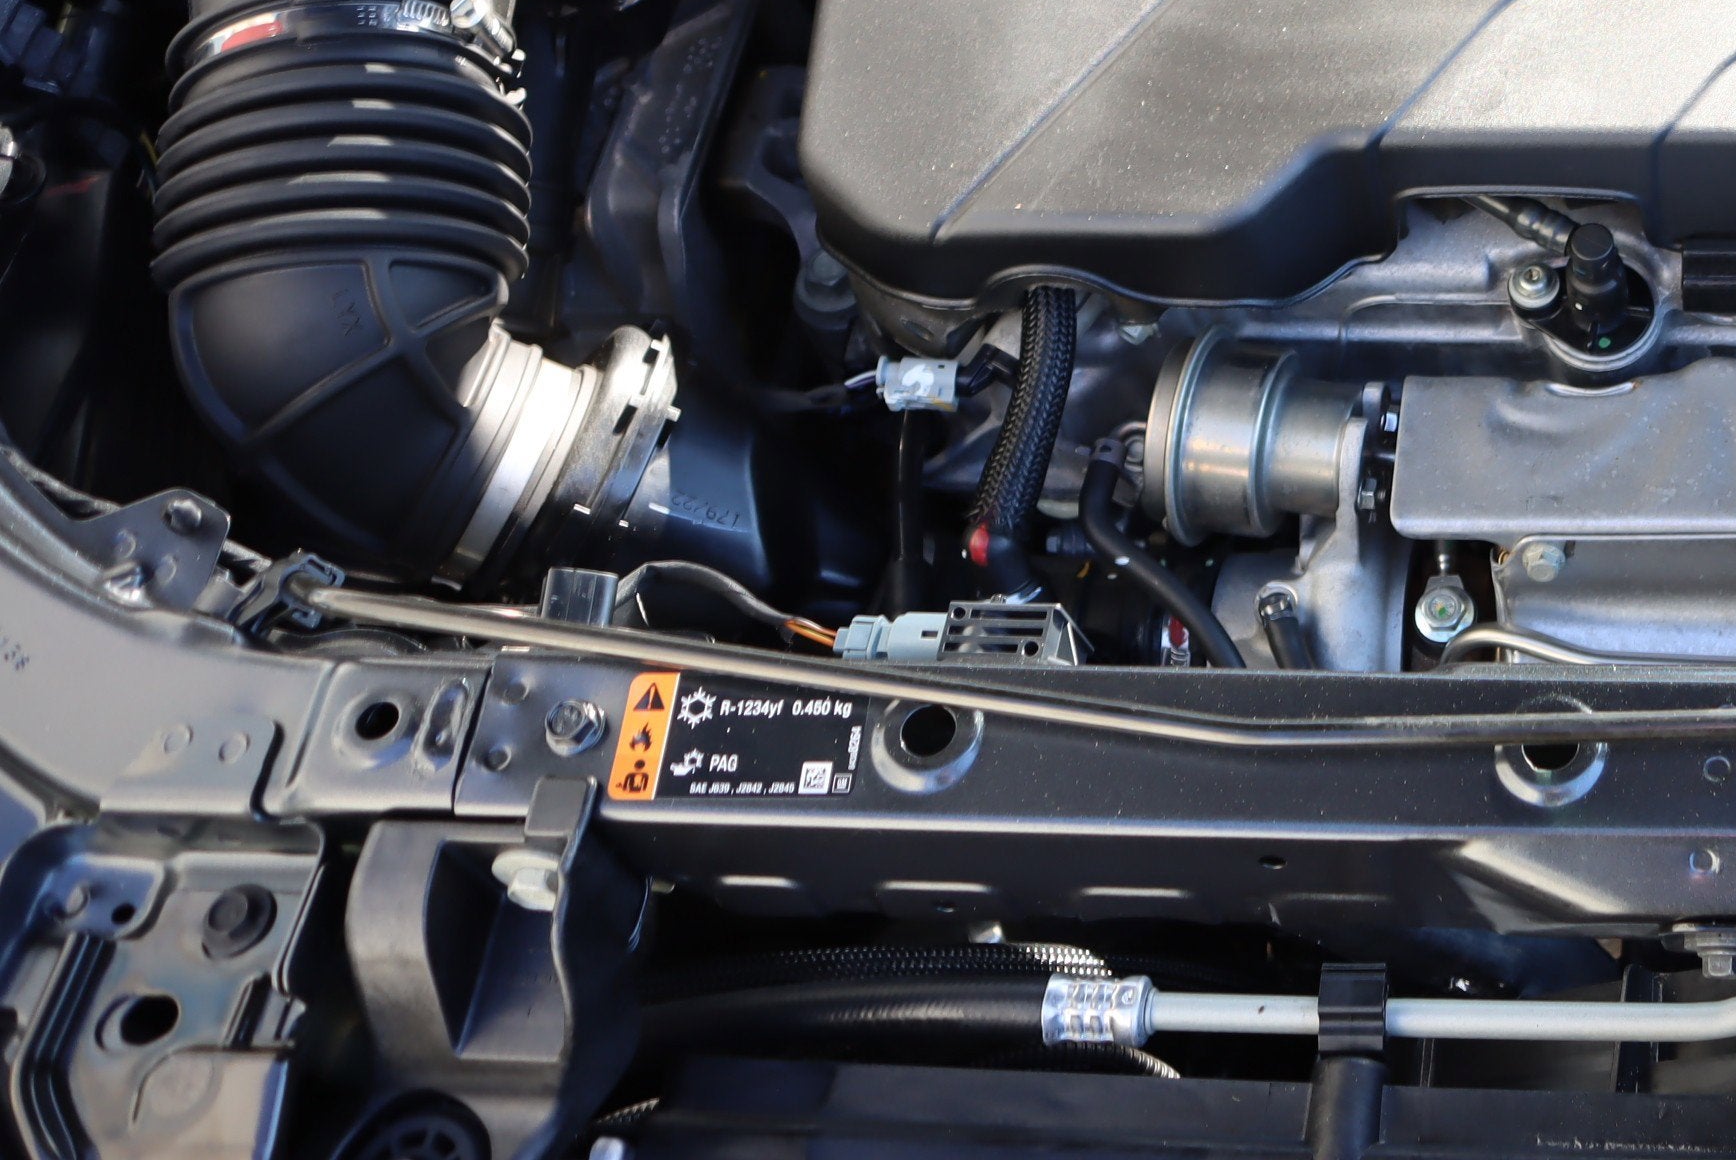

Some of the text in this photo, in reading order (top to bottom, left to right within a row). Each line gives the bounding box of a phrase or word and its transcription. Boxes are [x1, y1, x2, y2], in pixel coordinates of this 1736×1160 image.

[719, 699, 784, 718] R-1234yf
[833, 699, 853, 719] kg
[709, 754, 738, 772] PAG
